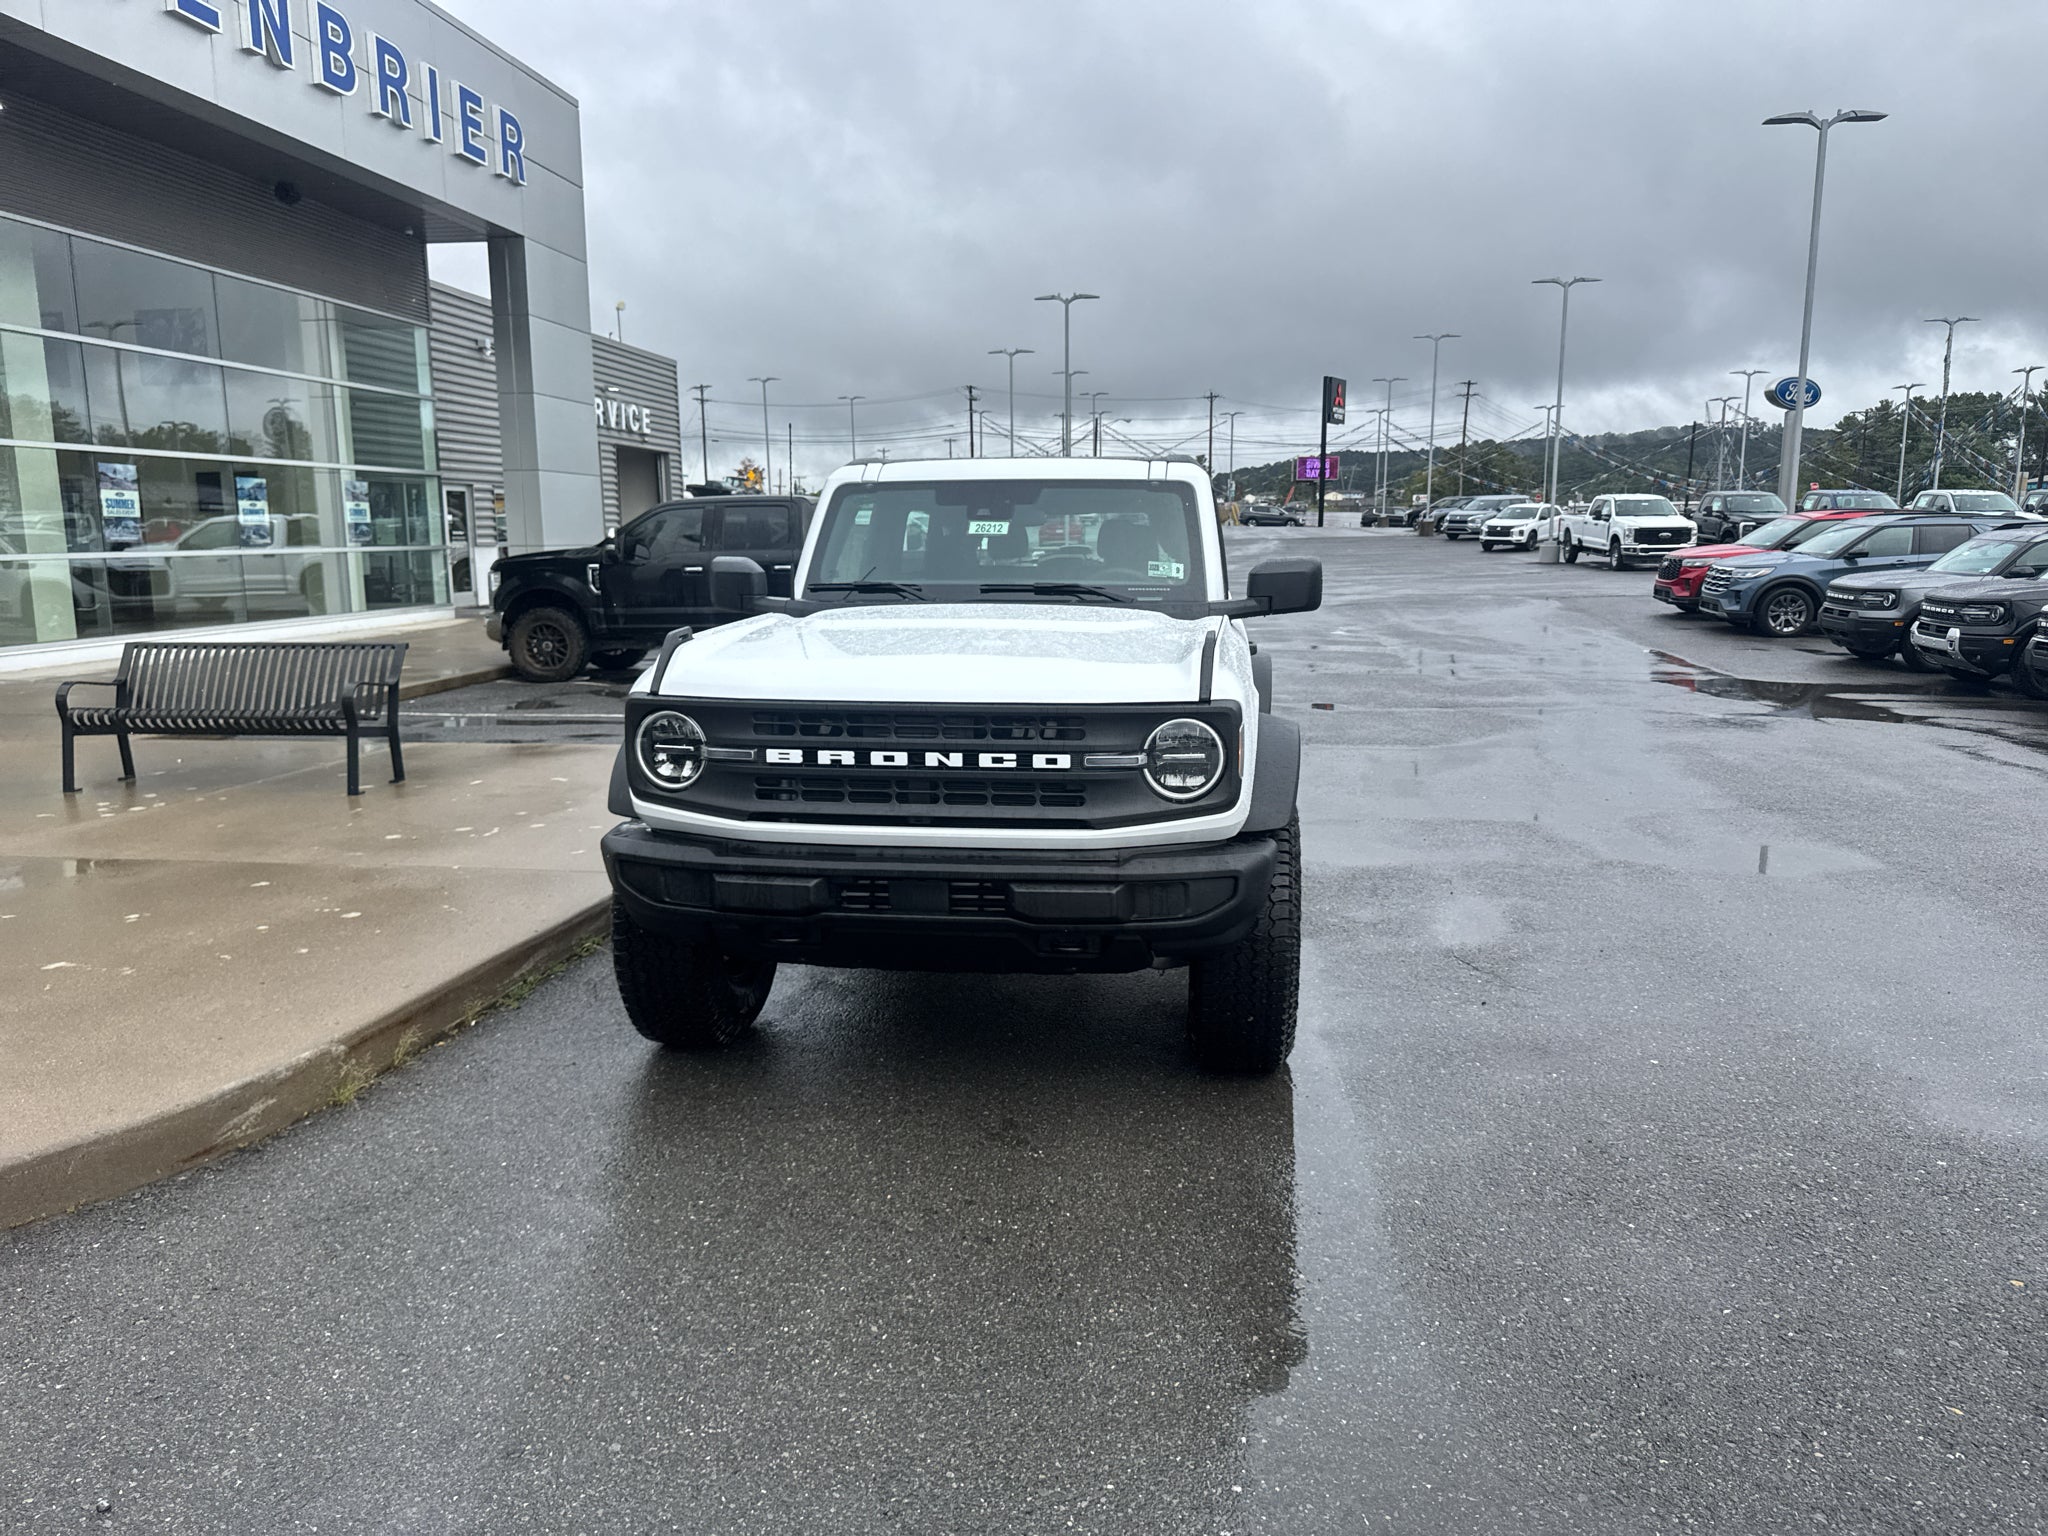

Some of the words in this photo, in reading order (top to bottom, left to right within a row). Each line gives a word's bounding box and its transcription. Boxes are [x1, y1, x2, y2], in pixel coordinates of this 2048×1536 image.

[166, 0, 527, 186] NBRIER
[105, 498, 136, 510] SUMMER
[975, 523, 1004, 533] 26212
[1922, 605, 1955, 614] BRONCO
[765, 748, 1061, 769] BRONCO
